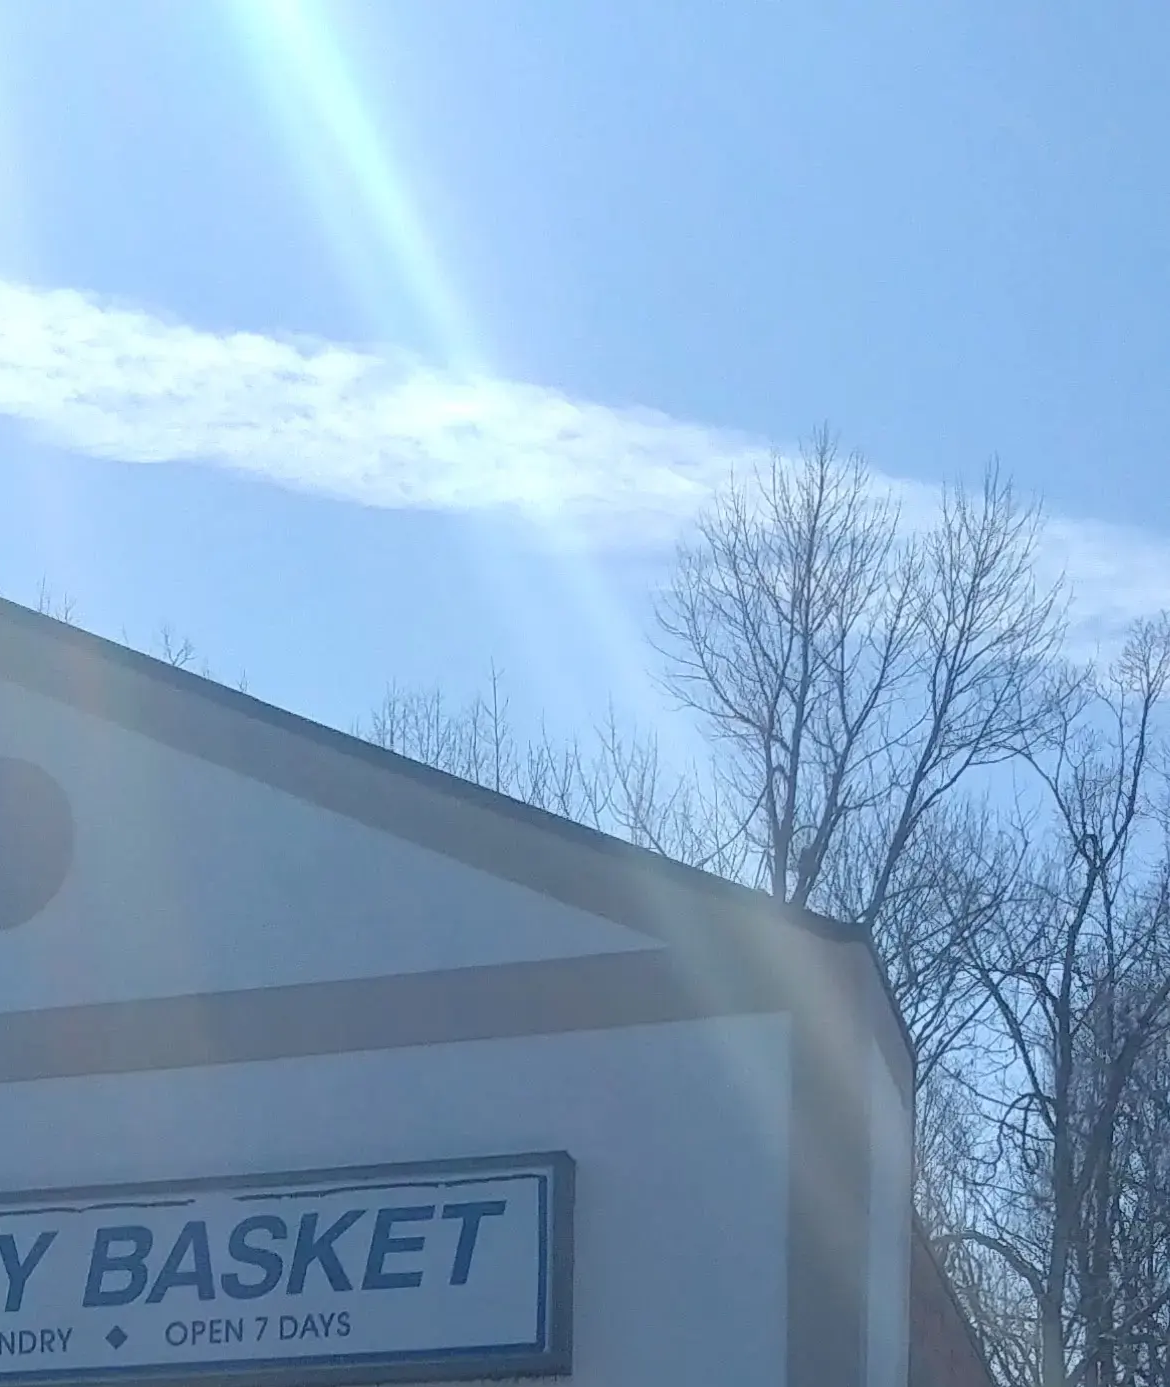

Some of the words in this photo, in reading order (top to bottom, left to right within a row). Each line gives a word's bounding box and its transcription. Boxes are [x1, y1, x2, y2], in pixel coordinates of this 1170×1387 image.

[82, 1199, 508, 1308] BASKET
[165, 1317, 243, 1346] OPEN
[255, 1316, 268, 1342] 7
[279, 1311, 352, 1341] DAYS
